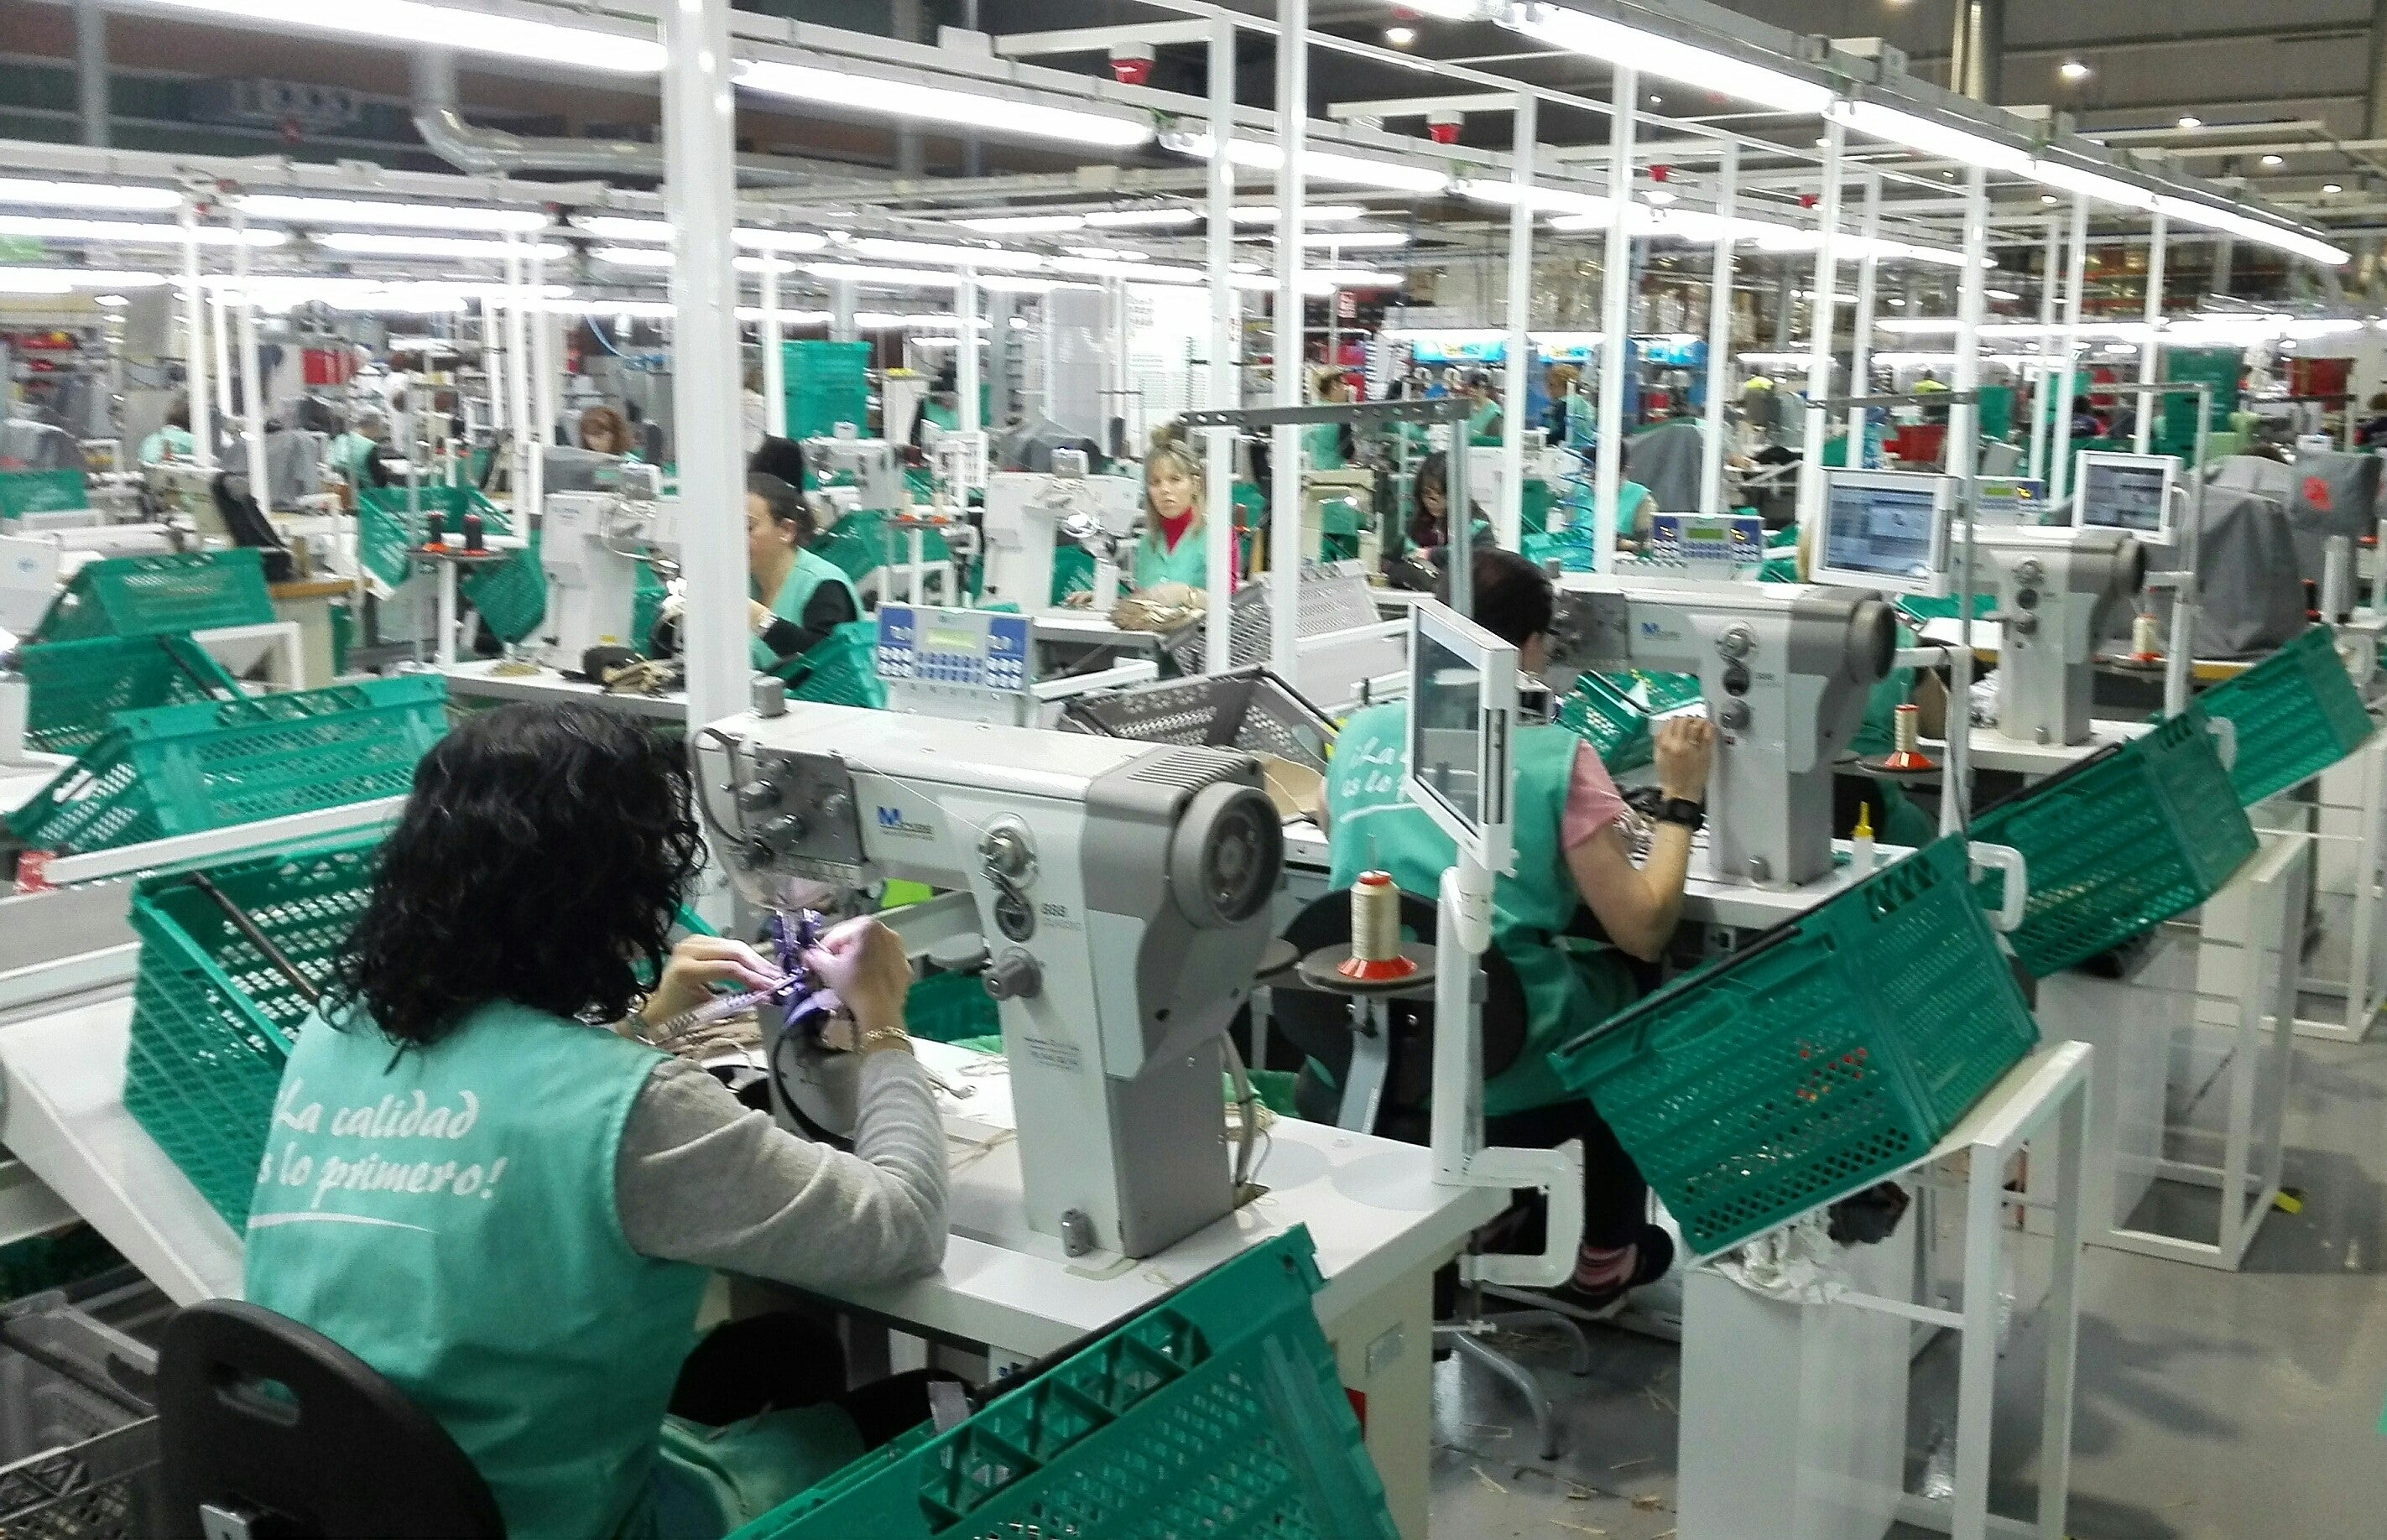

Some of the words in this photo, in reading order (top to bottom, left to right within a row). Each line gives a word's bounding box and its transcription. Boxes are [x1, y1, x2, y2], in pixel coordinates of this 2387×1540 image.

[274, 1077, 322, 1133] La
[331, 1089, 481, 1139] calidad
[279, 1141, 313, 1186] lo
[309, 1152, 508, 1210] primero!
